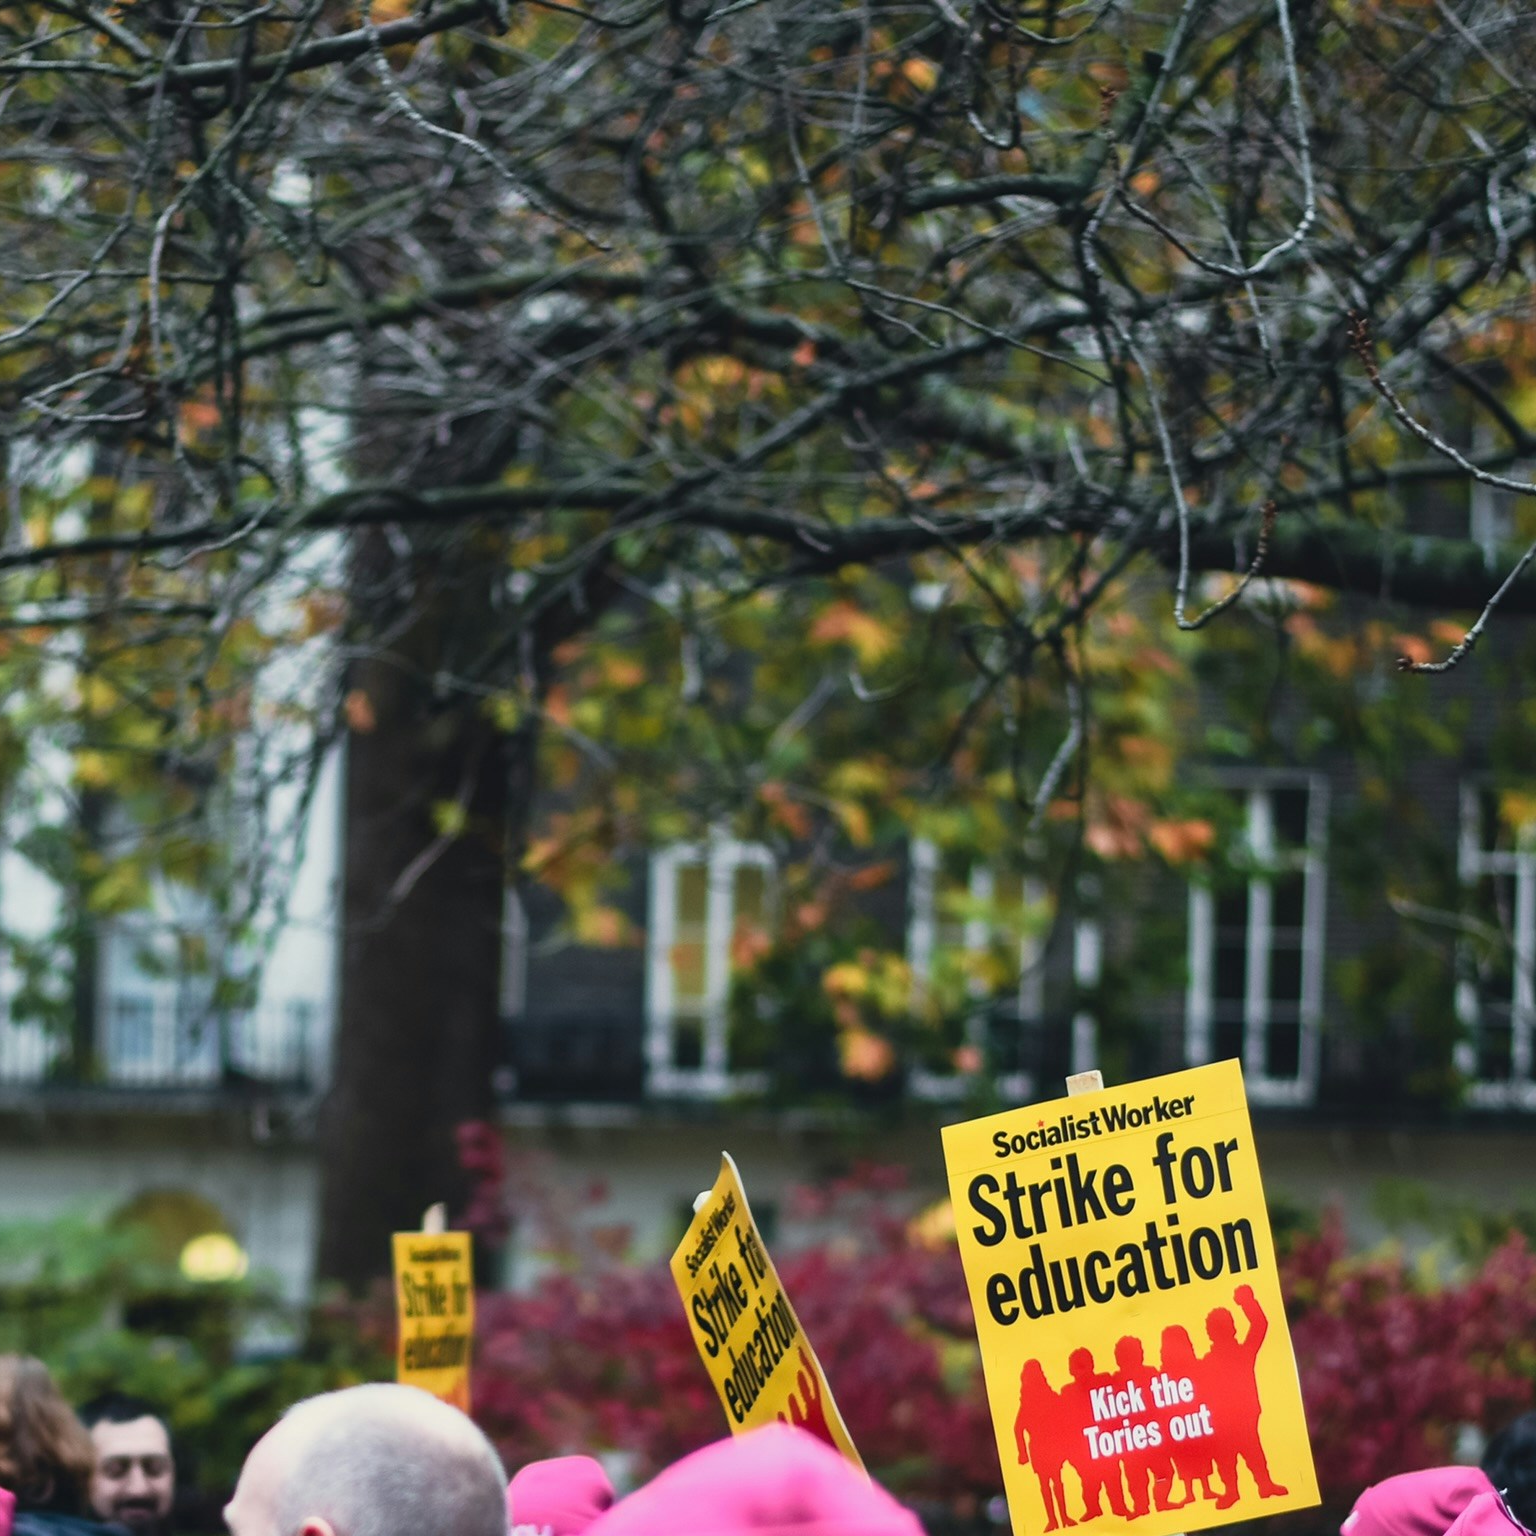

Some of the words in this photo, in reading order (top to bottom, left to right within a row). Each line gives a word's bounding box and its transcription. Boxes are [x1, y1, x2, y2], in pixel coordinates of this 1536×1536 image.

[968, 1152, 1136, 1247] Strike
[1152, 1132, 1239, 1206] for
[692, 1260, 749, 1358] Strike
[986, 1213, 1259, 1327] education
[724, 1295, 798, 1425] education
[1089, 1383, 1146, 1423] Kick
[1149, 1372, 1195, 1408] the
[1083, 1418, 1162, 1460] Tories
[1169, 1403, 1214, 1441] out
